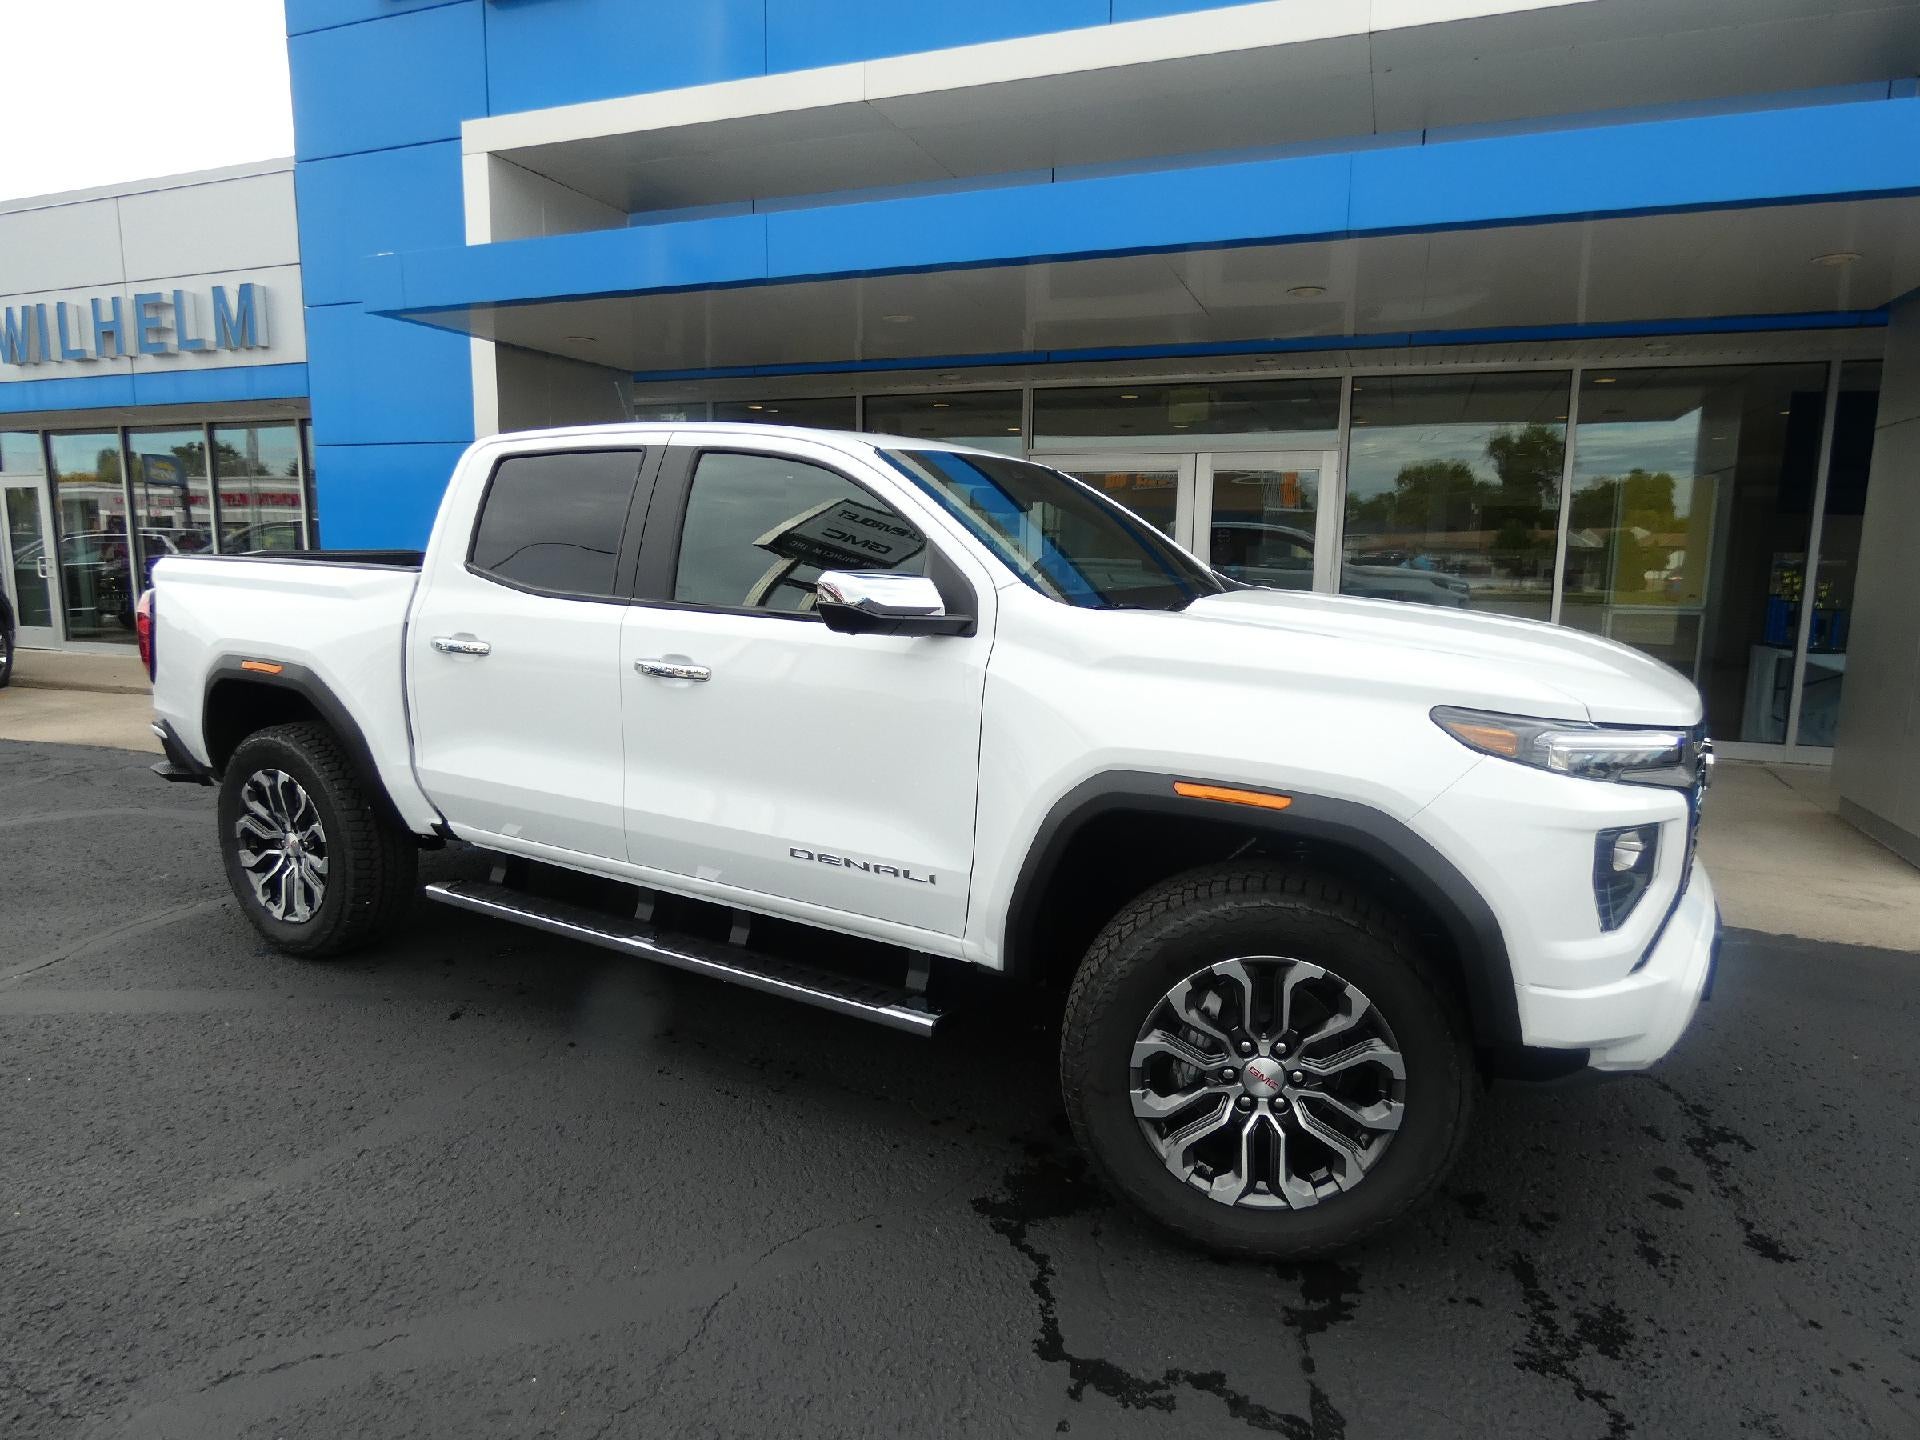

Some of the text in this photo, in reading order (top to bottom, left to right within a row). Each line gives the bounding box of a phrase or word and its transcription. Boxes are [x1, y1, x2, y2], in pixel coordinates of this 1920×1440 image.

[0, 282, 262, 365] WILHELM
[789, 847, 937, 886] DENALI
[1248, 1066, 1279, 1091] GMC
